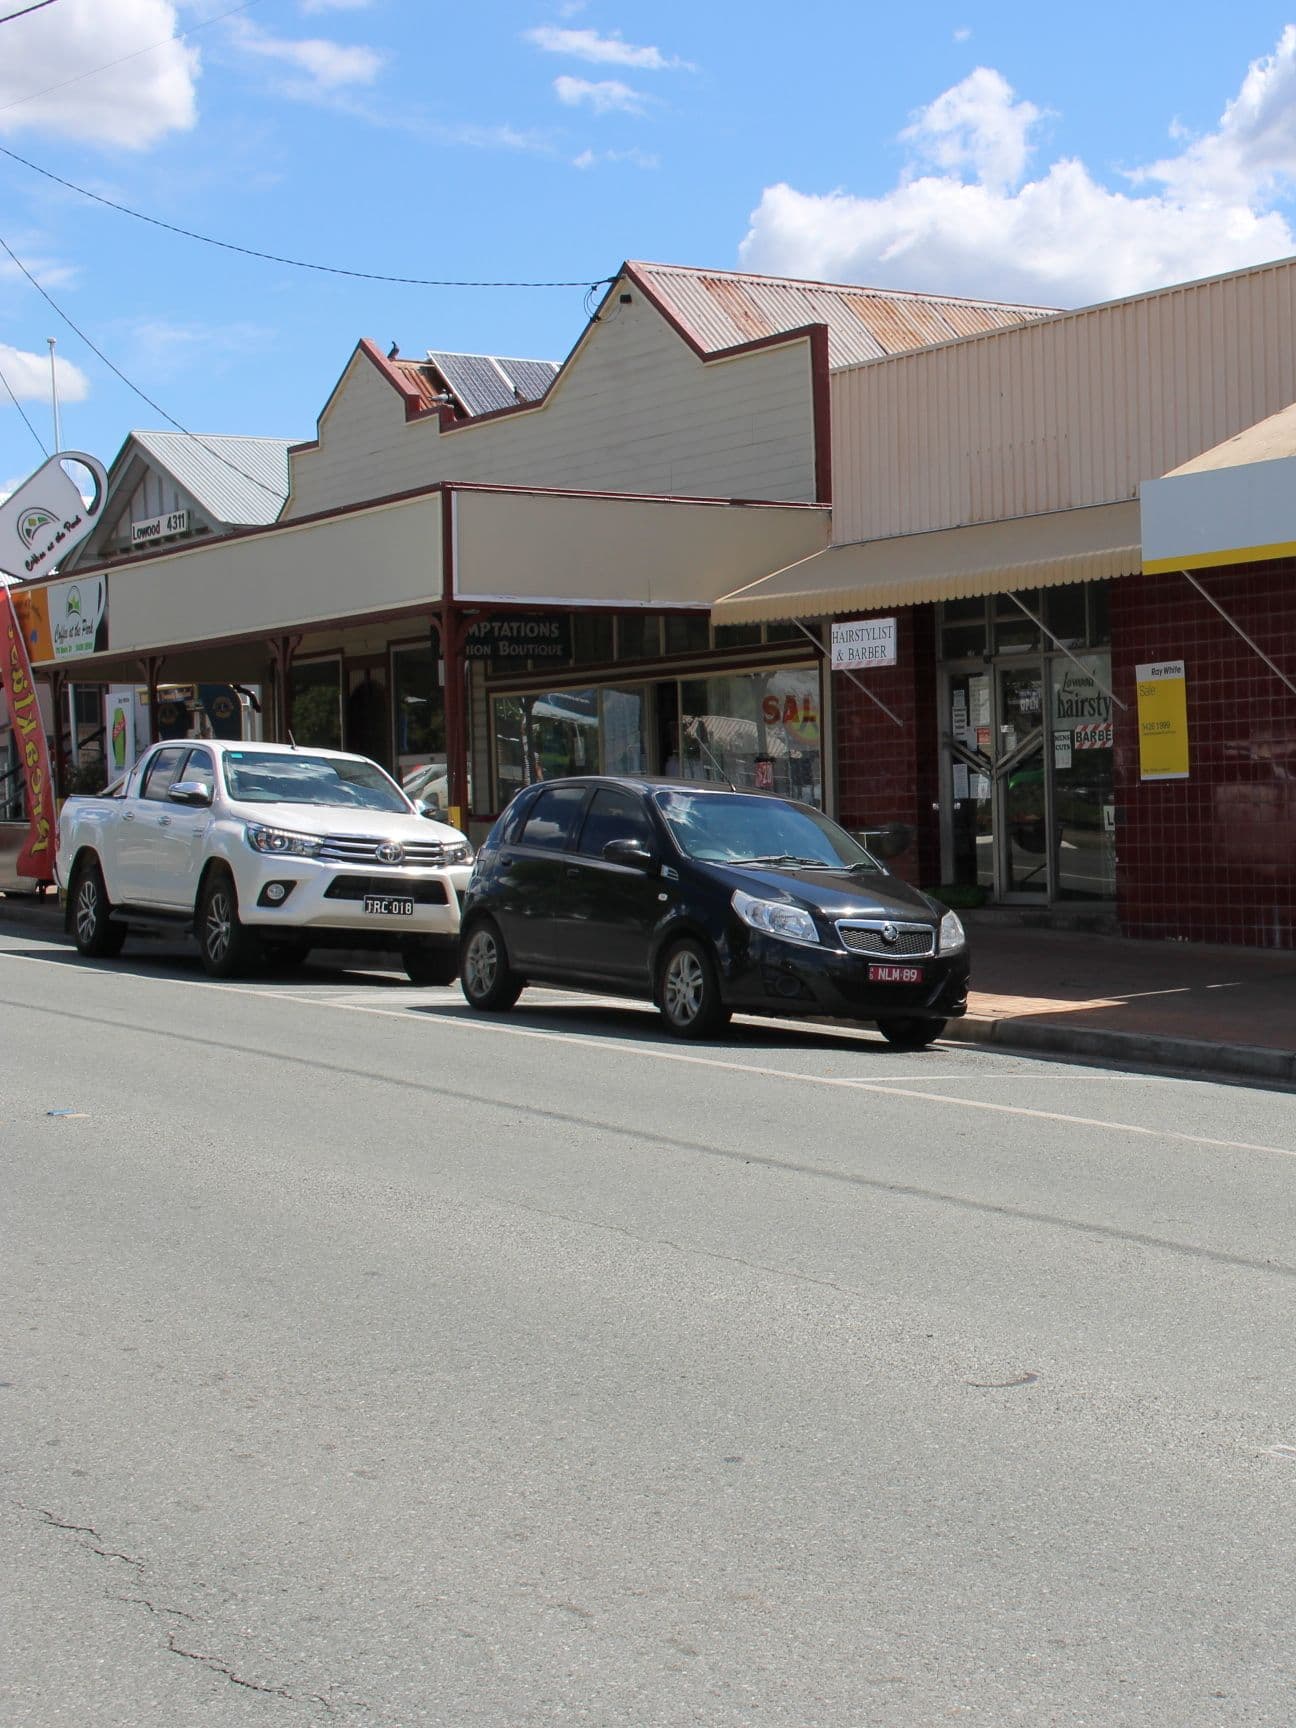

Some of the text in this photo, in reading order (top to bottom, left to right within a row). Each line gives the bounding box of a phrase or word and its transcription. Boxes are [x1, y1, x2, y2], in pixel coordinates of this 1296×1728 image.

[132, 513, 185, 541] Lowood 4311
[832, 625, 893, 645] HAIRSTYLIST
[836, 645, 887, 661] & BARBER
